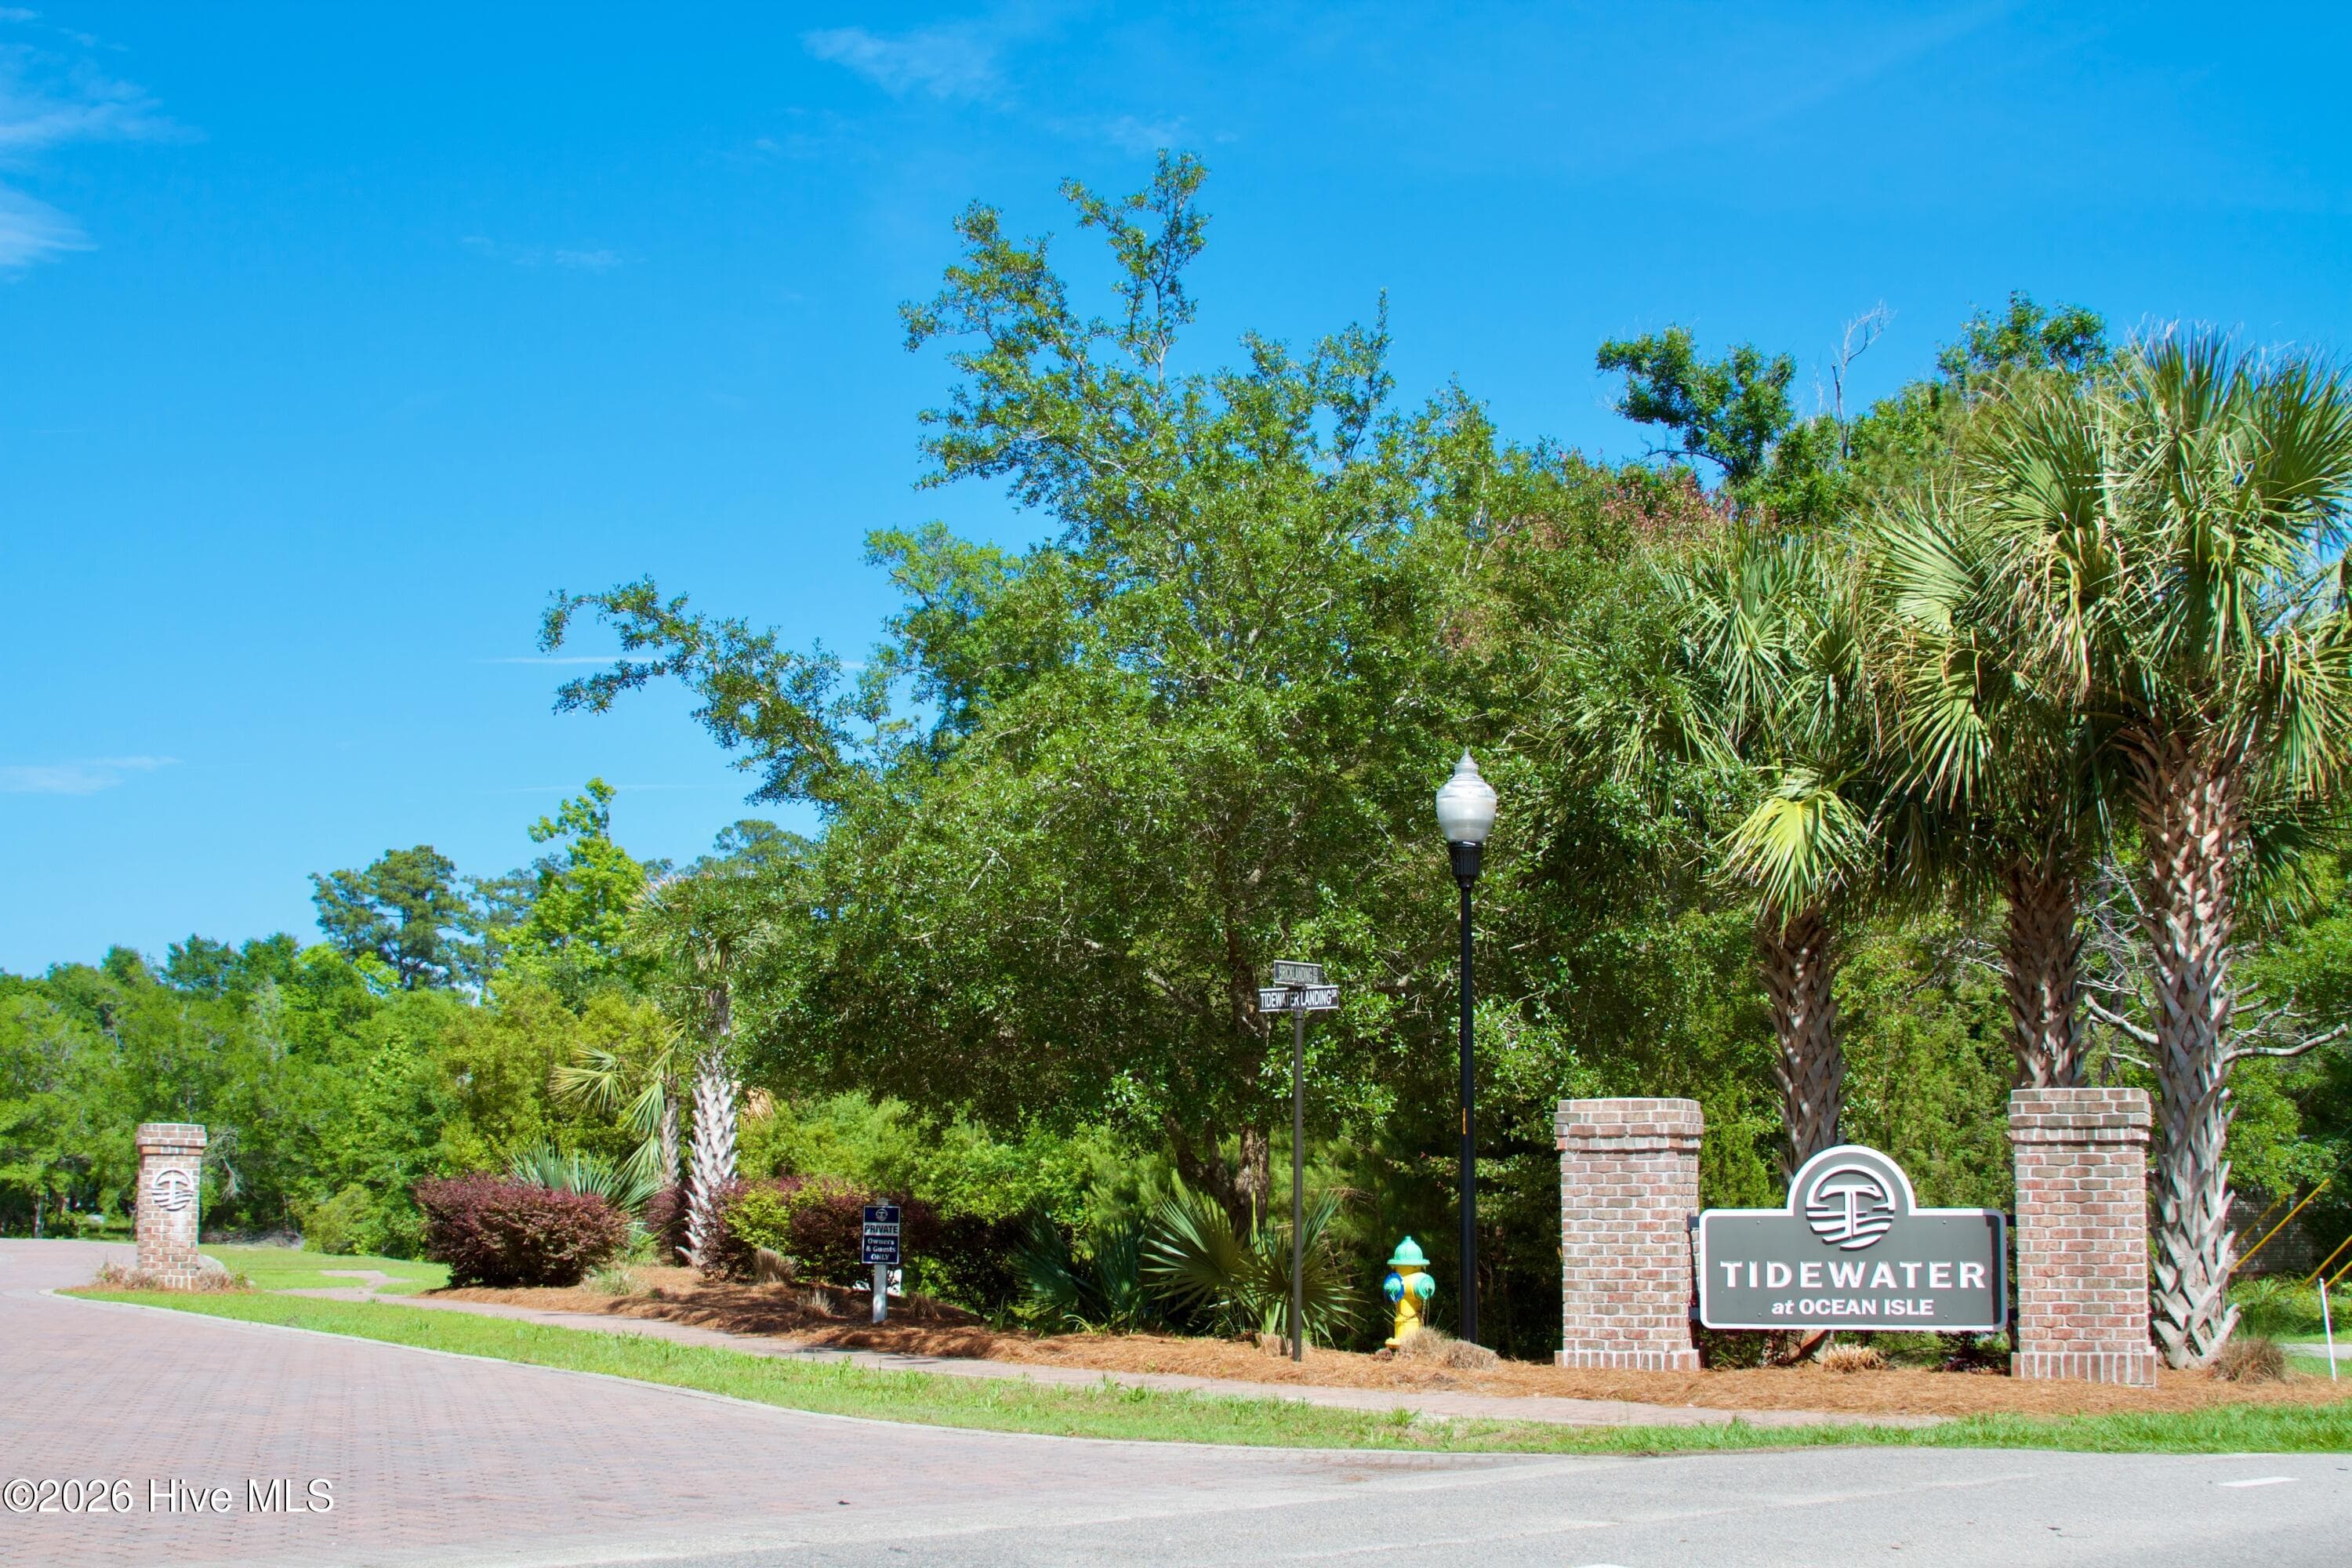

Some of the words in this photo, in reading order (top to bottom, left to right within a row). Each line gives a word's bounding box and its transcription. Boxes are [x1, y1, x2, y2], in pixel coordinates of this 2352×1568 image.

[1260, 992, 1299, 1007] TIDEWATER
[1301, 989, 1331, 1006] LANDING
[1331, 989, 1337, 997] DR
[864, 1225, 898, 1233] PRIVATE
[1720, 1261, 1986, 1289] TIDEWATER
[1772, 1300, 1794, 1315] at
[1798, 1299, 1876, 1316] OCEAN
[1884, 1299, 1934, 1316] ISLE
